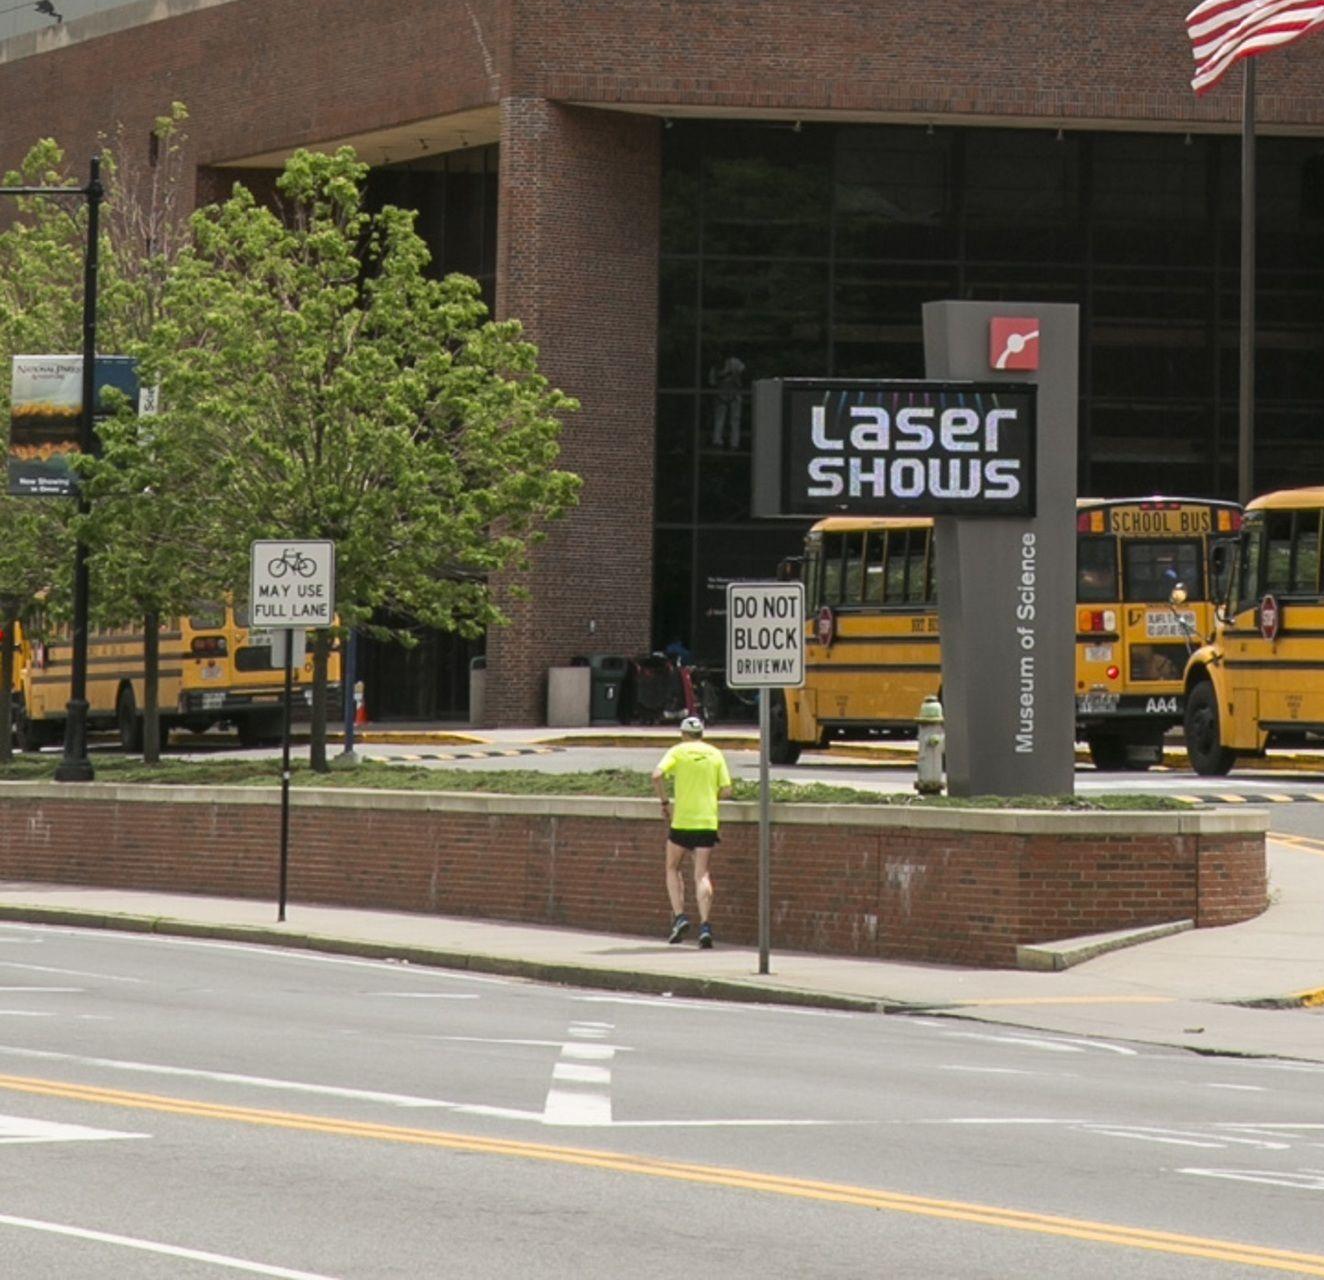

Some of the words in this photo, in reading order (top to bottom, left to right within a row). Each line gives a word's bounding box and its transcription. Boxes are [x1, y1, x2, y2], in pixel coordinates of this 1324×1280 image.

[811, 406, 1017, 452] Laser
[807, 457, 1020, 498] SHOWS
[1112, 512, 1169, 532] SCHOOL
[1180, 512, 1211, 532] BUS
[1016, 532, 1036, 620] Science
[259, 584, 291, 597] MAY
[297, 584, 324, 597] USE
[255, 603, 287, 617] FULL
[292, 603, 328, 617] LANE
[734, 596, 757, 618] DO
[763, 596, 798, 618] NOT
[735, 628, 798, 649] BLOCK
[1017, 627, 1035, 650] of
[737, 658, 795, 674] DRIVEWAY
[1015, 656, 1034, 753] Museum
[1146, 697, 1178, 713] AA4
